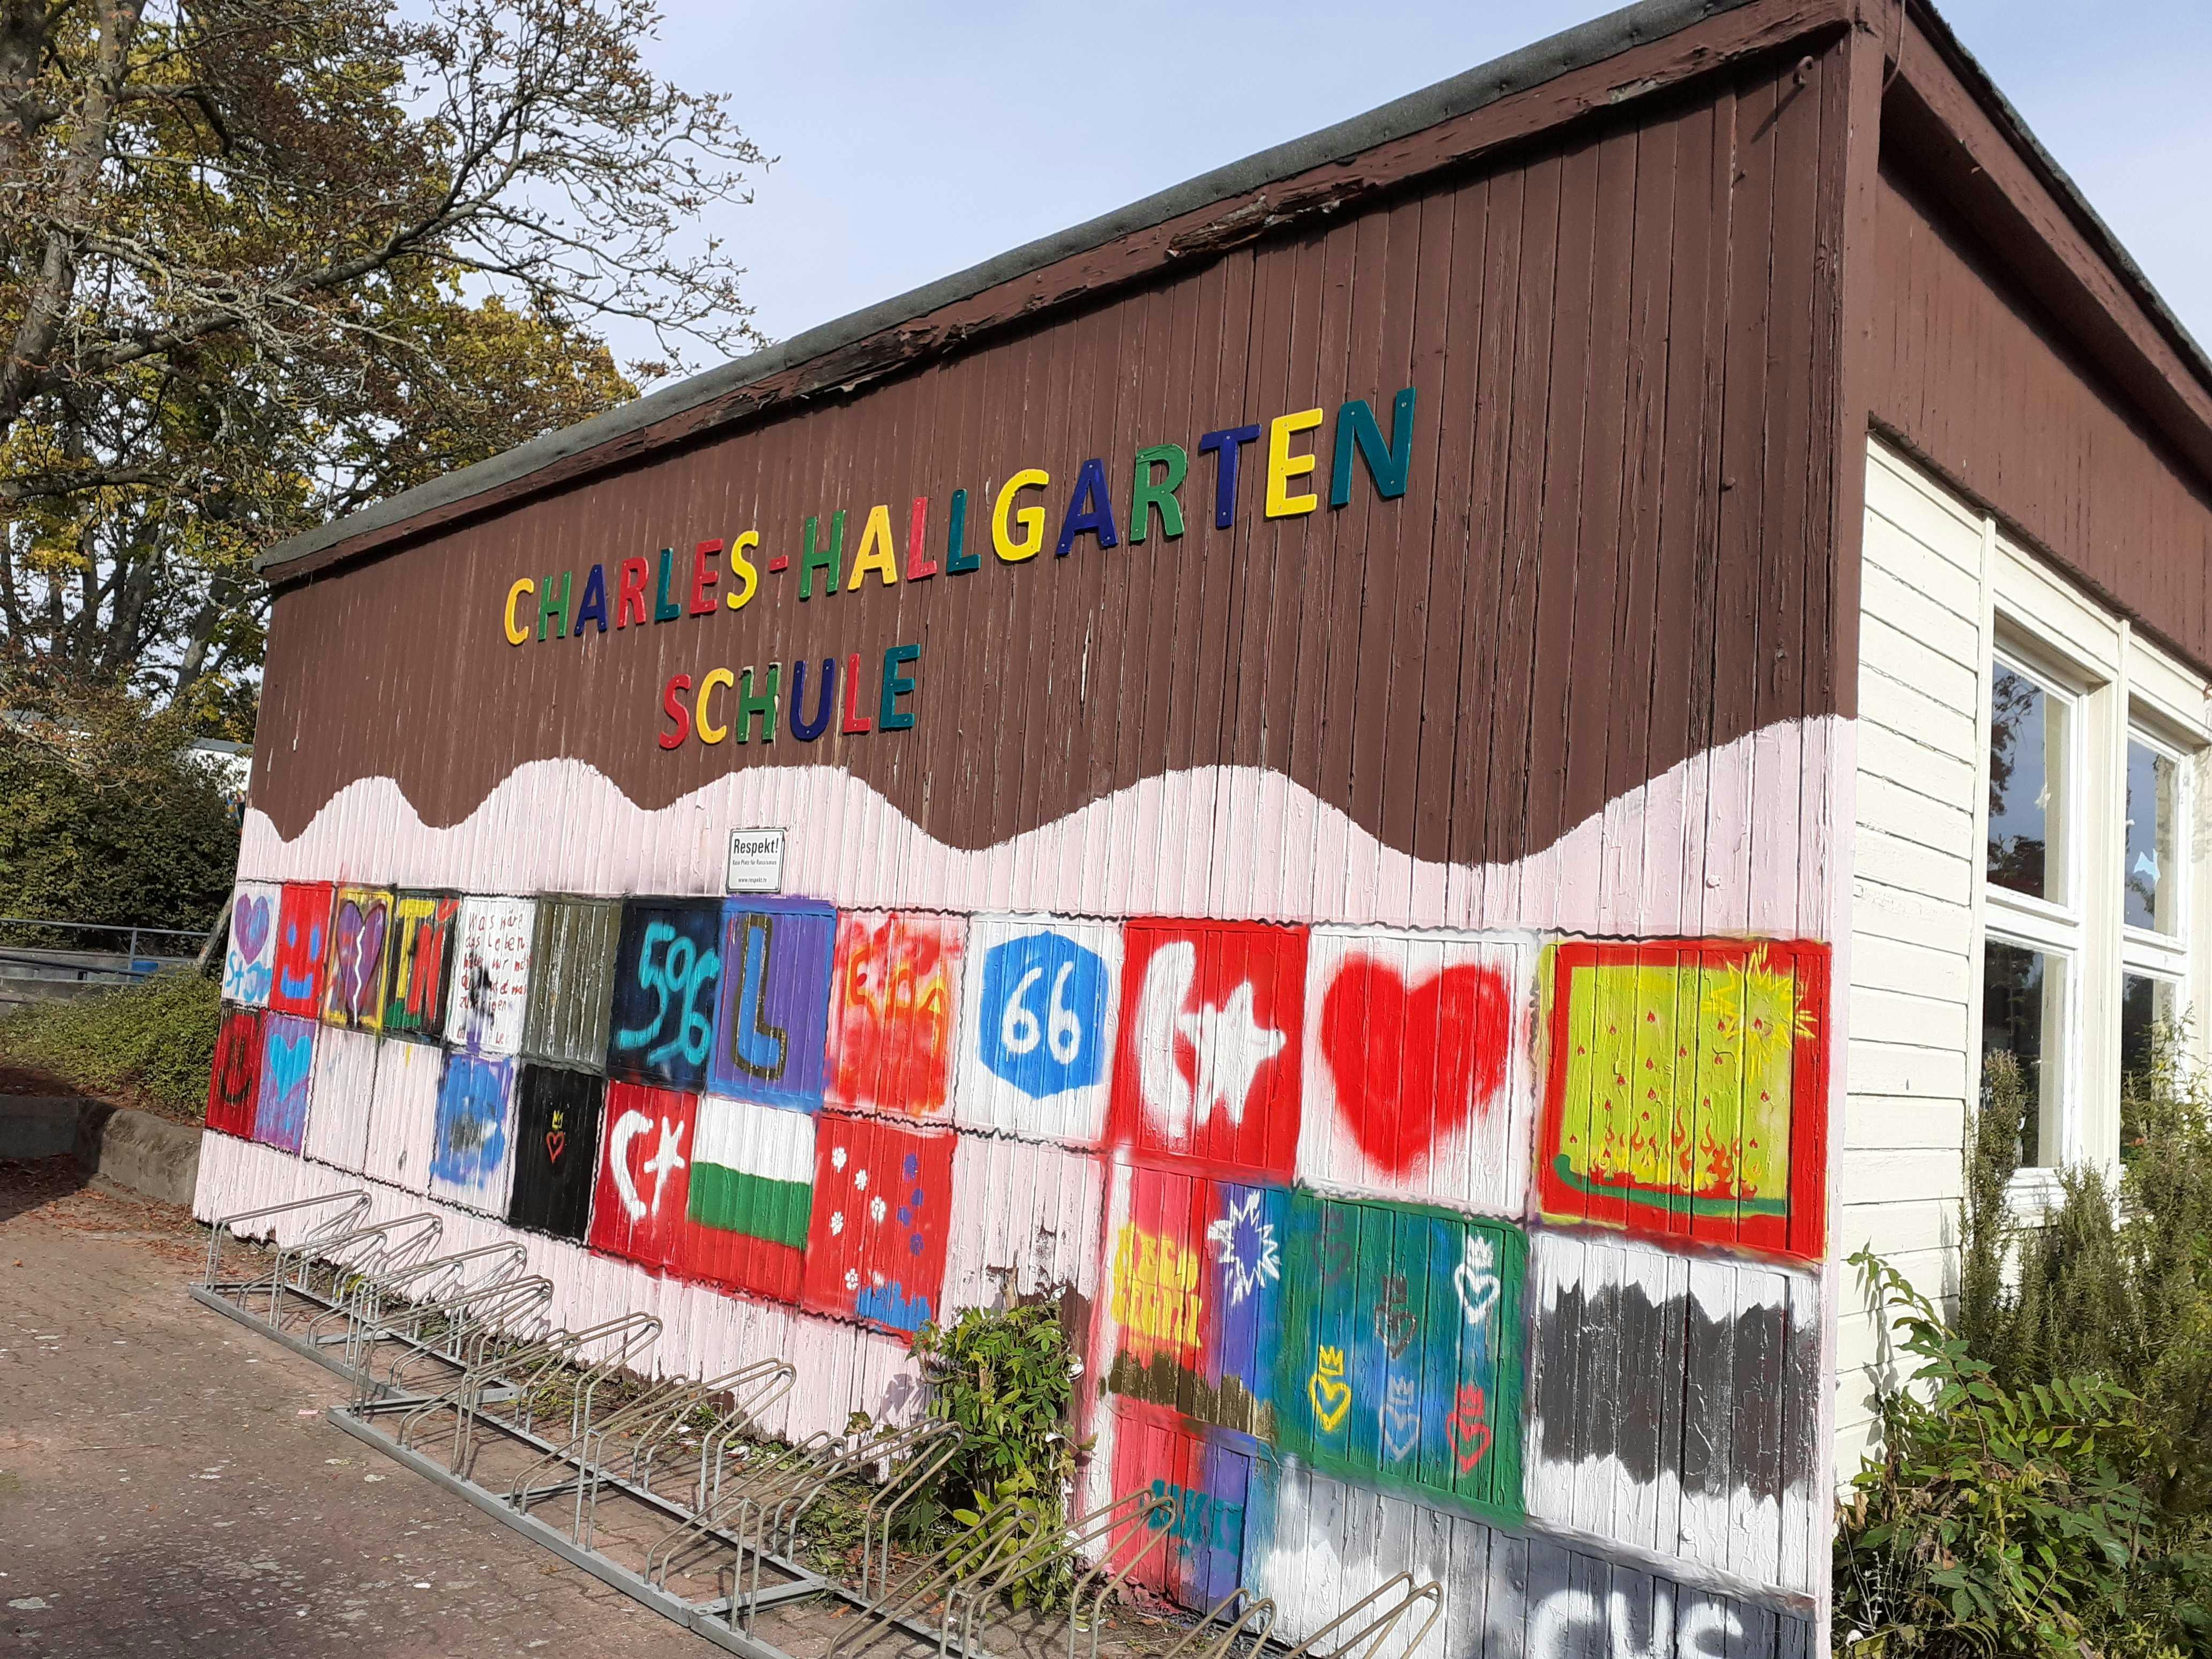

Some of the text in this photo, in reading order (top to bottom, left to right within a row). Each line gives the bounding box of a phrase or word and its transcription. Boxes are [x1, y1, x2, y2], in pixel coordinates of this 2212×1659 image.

[504, 386, 1416, 646] CHARLES-HALLGARTEN
[659, 643, 921, 750] SCHULE
[733, 838, 779, 857] Respekt!
[1002, 961, 1082, 1065] 66
